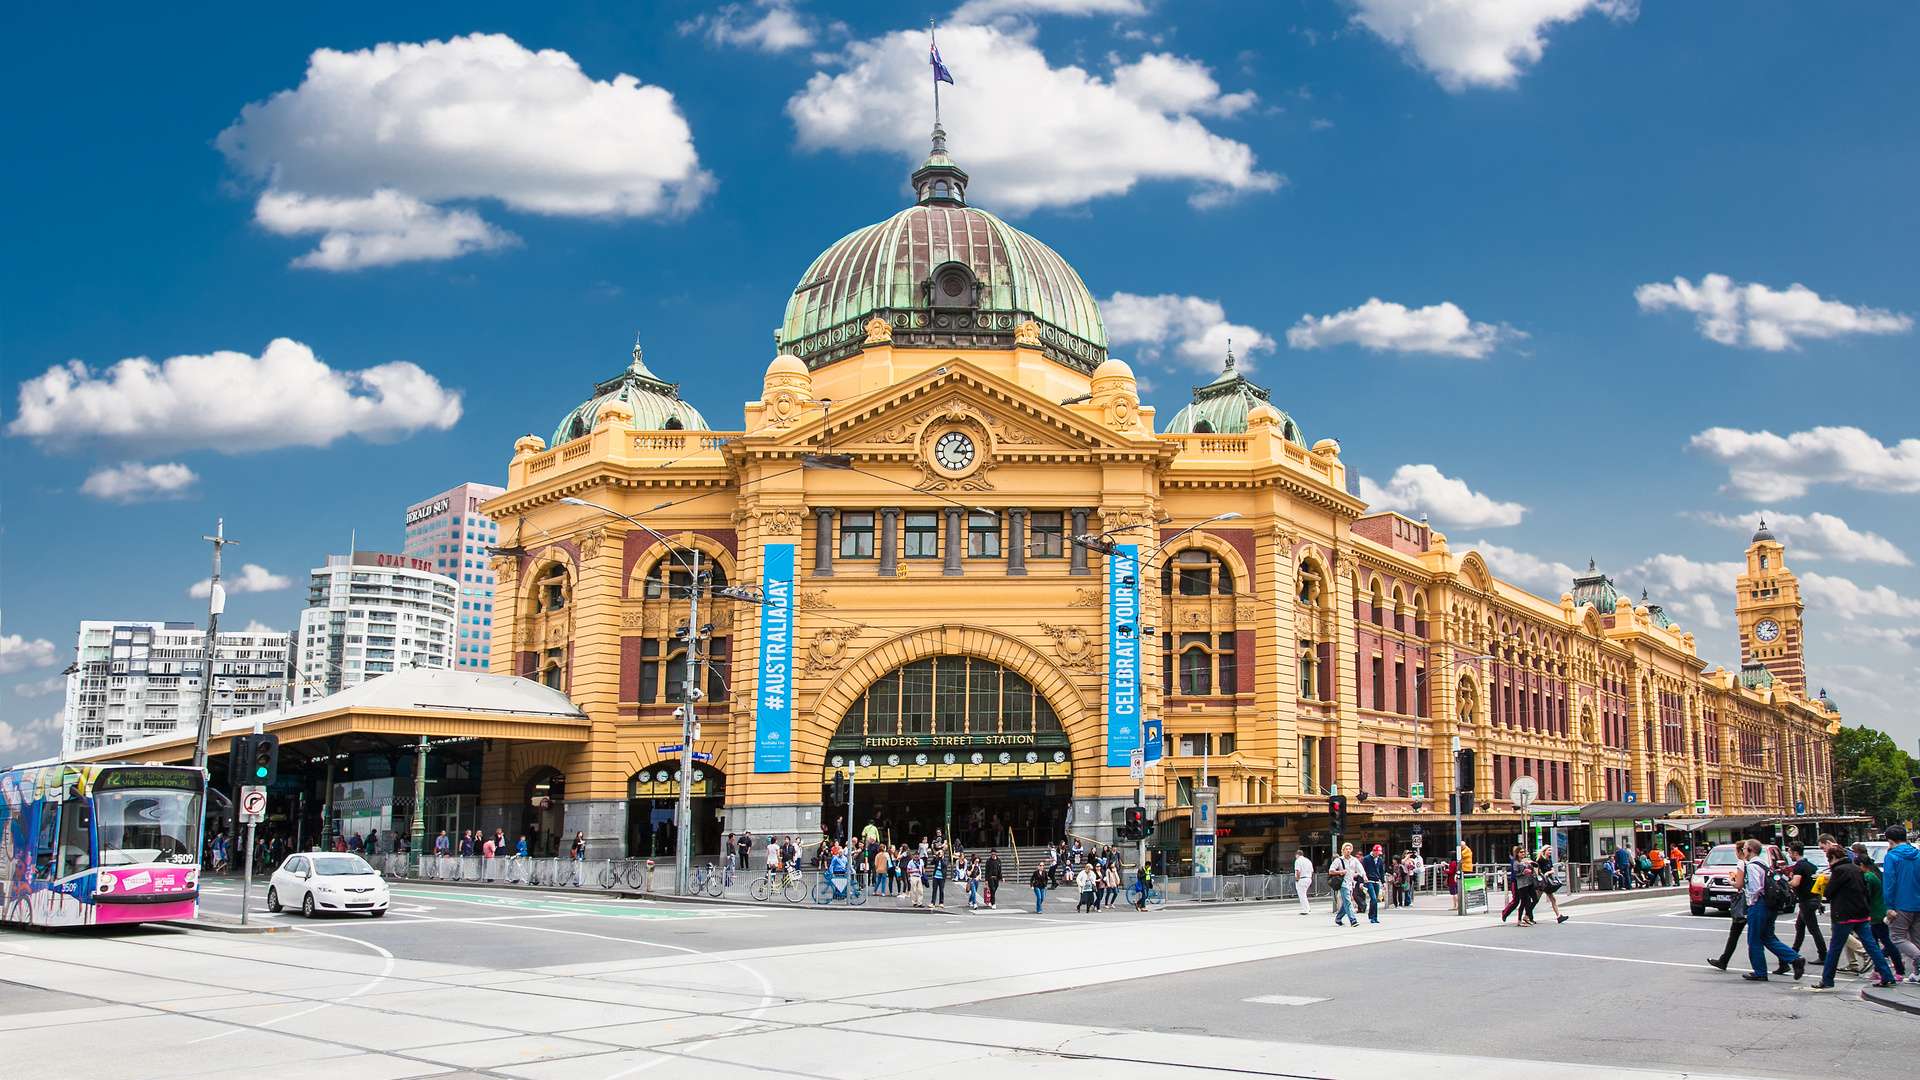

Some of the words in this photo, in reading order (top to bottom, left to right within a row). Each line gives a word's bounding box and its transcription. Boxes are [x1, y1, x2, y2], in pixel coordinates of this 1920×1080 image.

[433, 499, 449, 514] SUN
[378, 554, 405, 567] QUAY
[411, 558, 432, 572] WEST
[1115, 554, 1134, 584] WAY
[1116, 588, 1134, 626] YOUR
[764, 578, 788, 711] #AUSTRALIADAY
[1115, 631, 1134, 715] CELEBRATE
[865, 737, 919, 747] FLINDERS
[932, 736, 974, 746] STREET
[986, 735, 1034, 745] STATION
[172, 854, 194, 864] 3509
[61, 883, 77, 892] 3509
